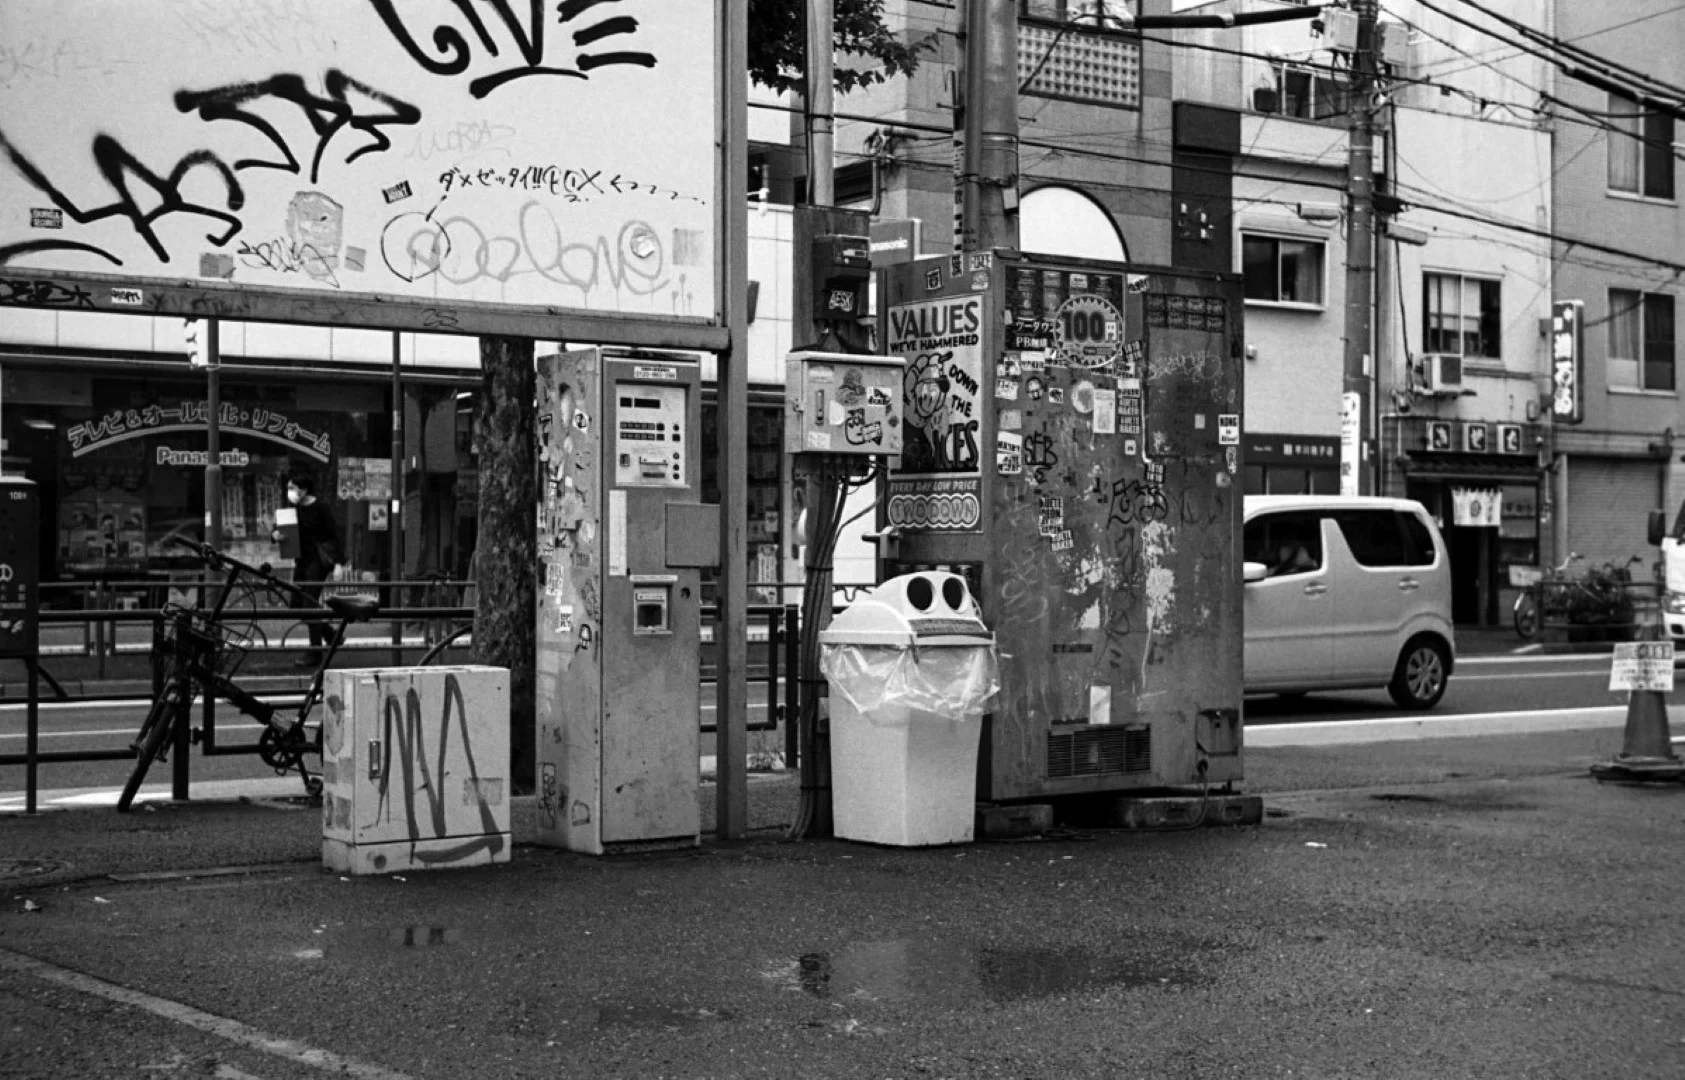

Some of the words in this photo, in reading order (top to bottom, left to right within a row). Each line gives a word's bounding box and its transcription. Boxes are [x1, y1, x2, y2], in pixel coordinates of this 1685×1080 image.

[890, 301, 979, 339] VALUES
[920, 333, 979, 350] HAMMERED
[949, 364, 979, 396] DOWN
[952, 394, 972, 418] THE
[157, 447, 249, 467] Panasnic
[933, 481, 951, 491] LOW
[953, 480, 977, 490] PRICE
